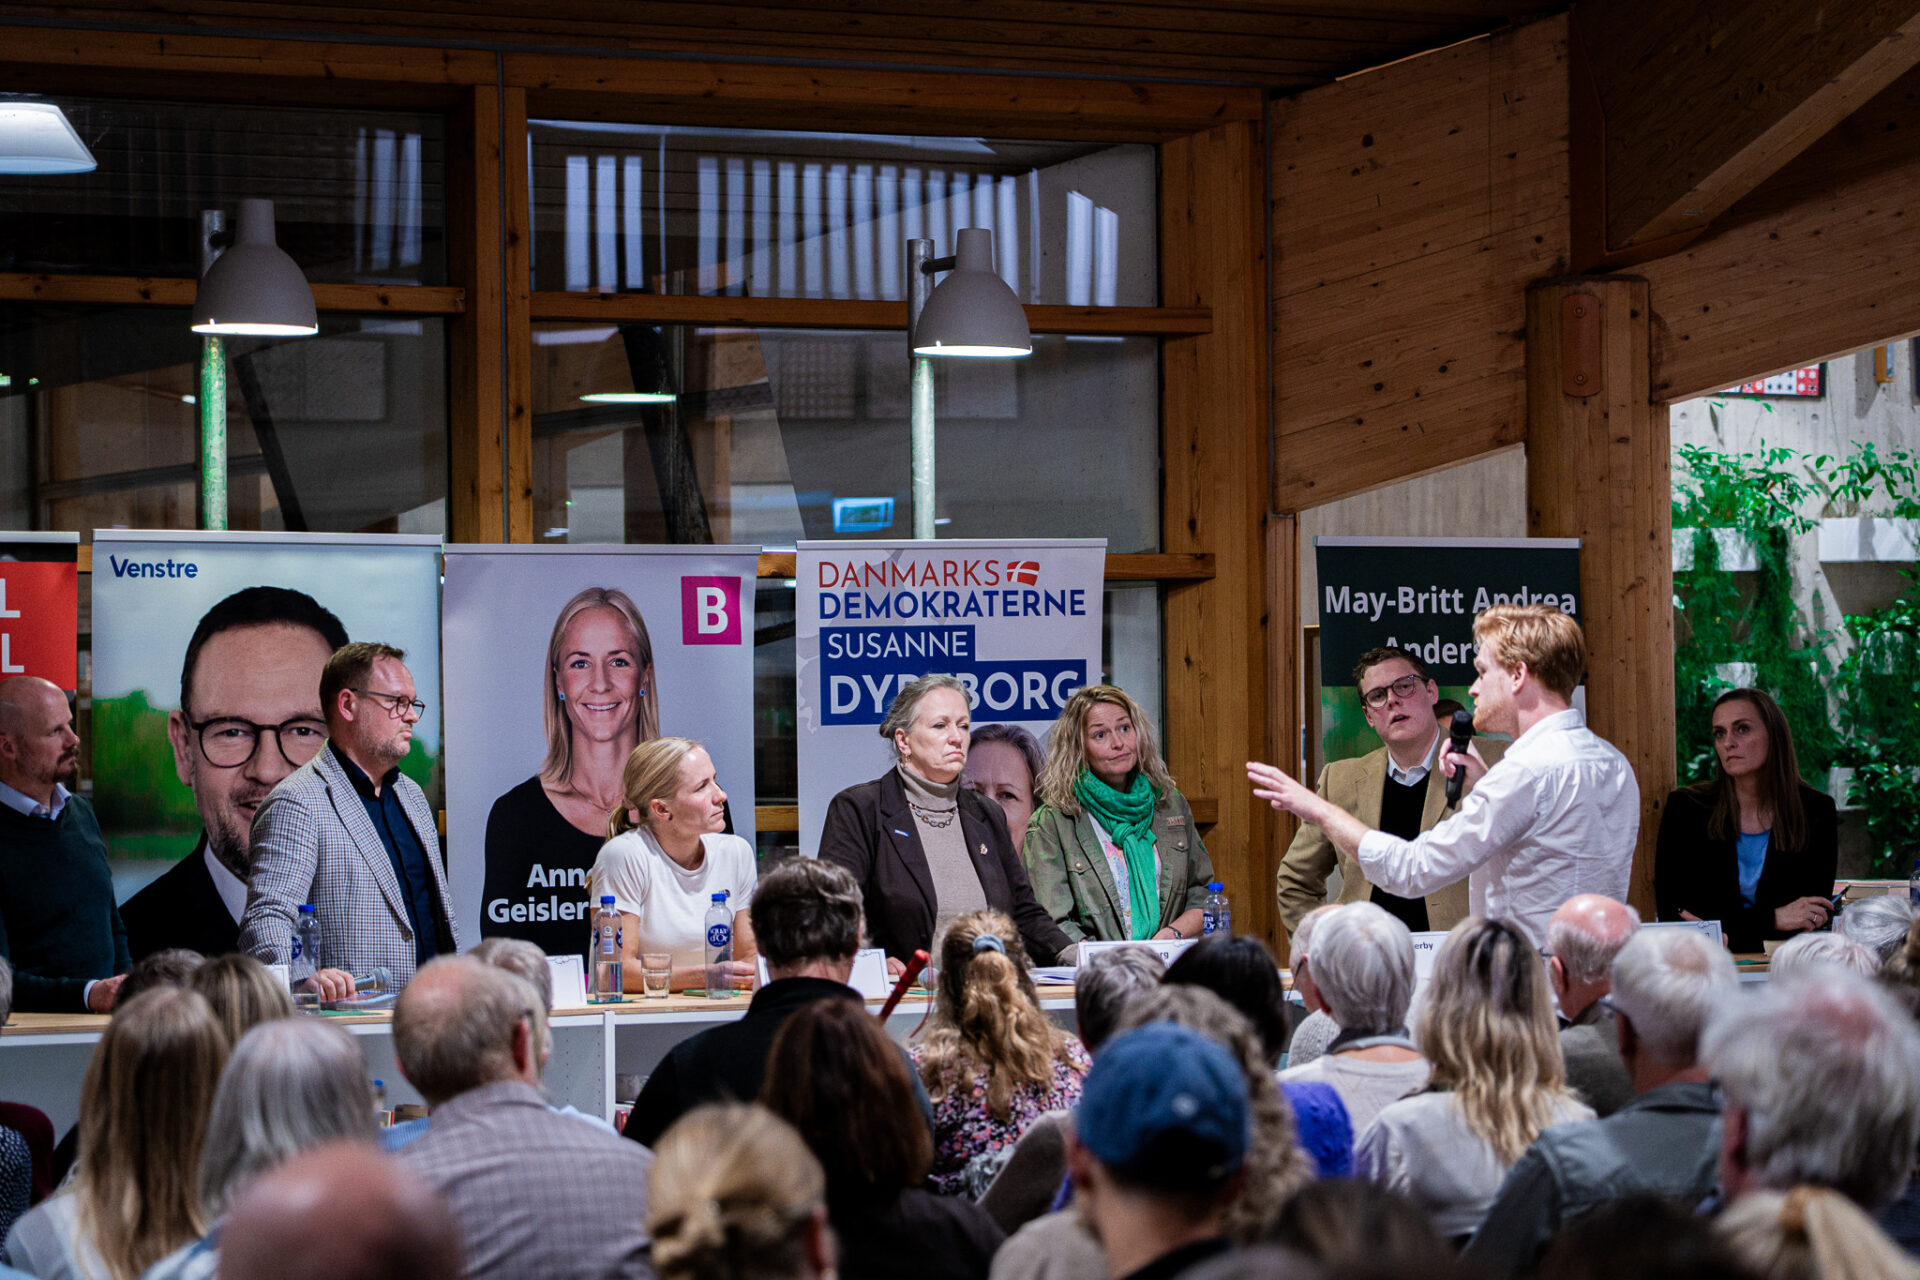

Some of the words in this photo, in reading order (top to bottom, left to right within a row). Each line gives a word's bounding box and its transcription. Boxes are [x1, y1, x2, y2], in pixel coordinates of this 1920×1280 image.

[109, 554, 198, 578] Venstre
[818, 559, 1000, 588] DANMARKS
[696, 586, 728, 634] B
[819, 589, 1086, 619] DEMOKRATERNE
[1325, 585, 1464, 622] May-Britt
[827, 631, 968, 659] SUSANNE
[830, 670, 1080, 714] DYBORG
[527, 863, 592, 888] Ann
[487, 895, 590, 923] Geisler
[1414, 941, 1434, 951] erby
